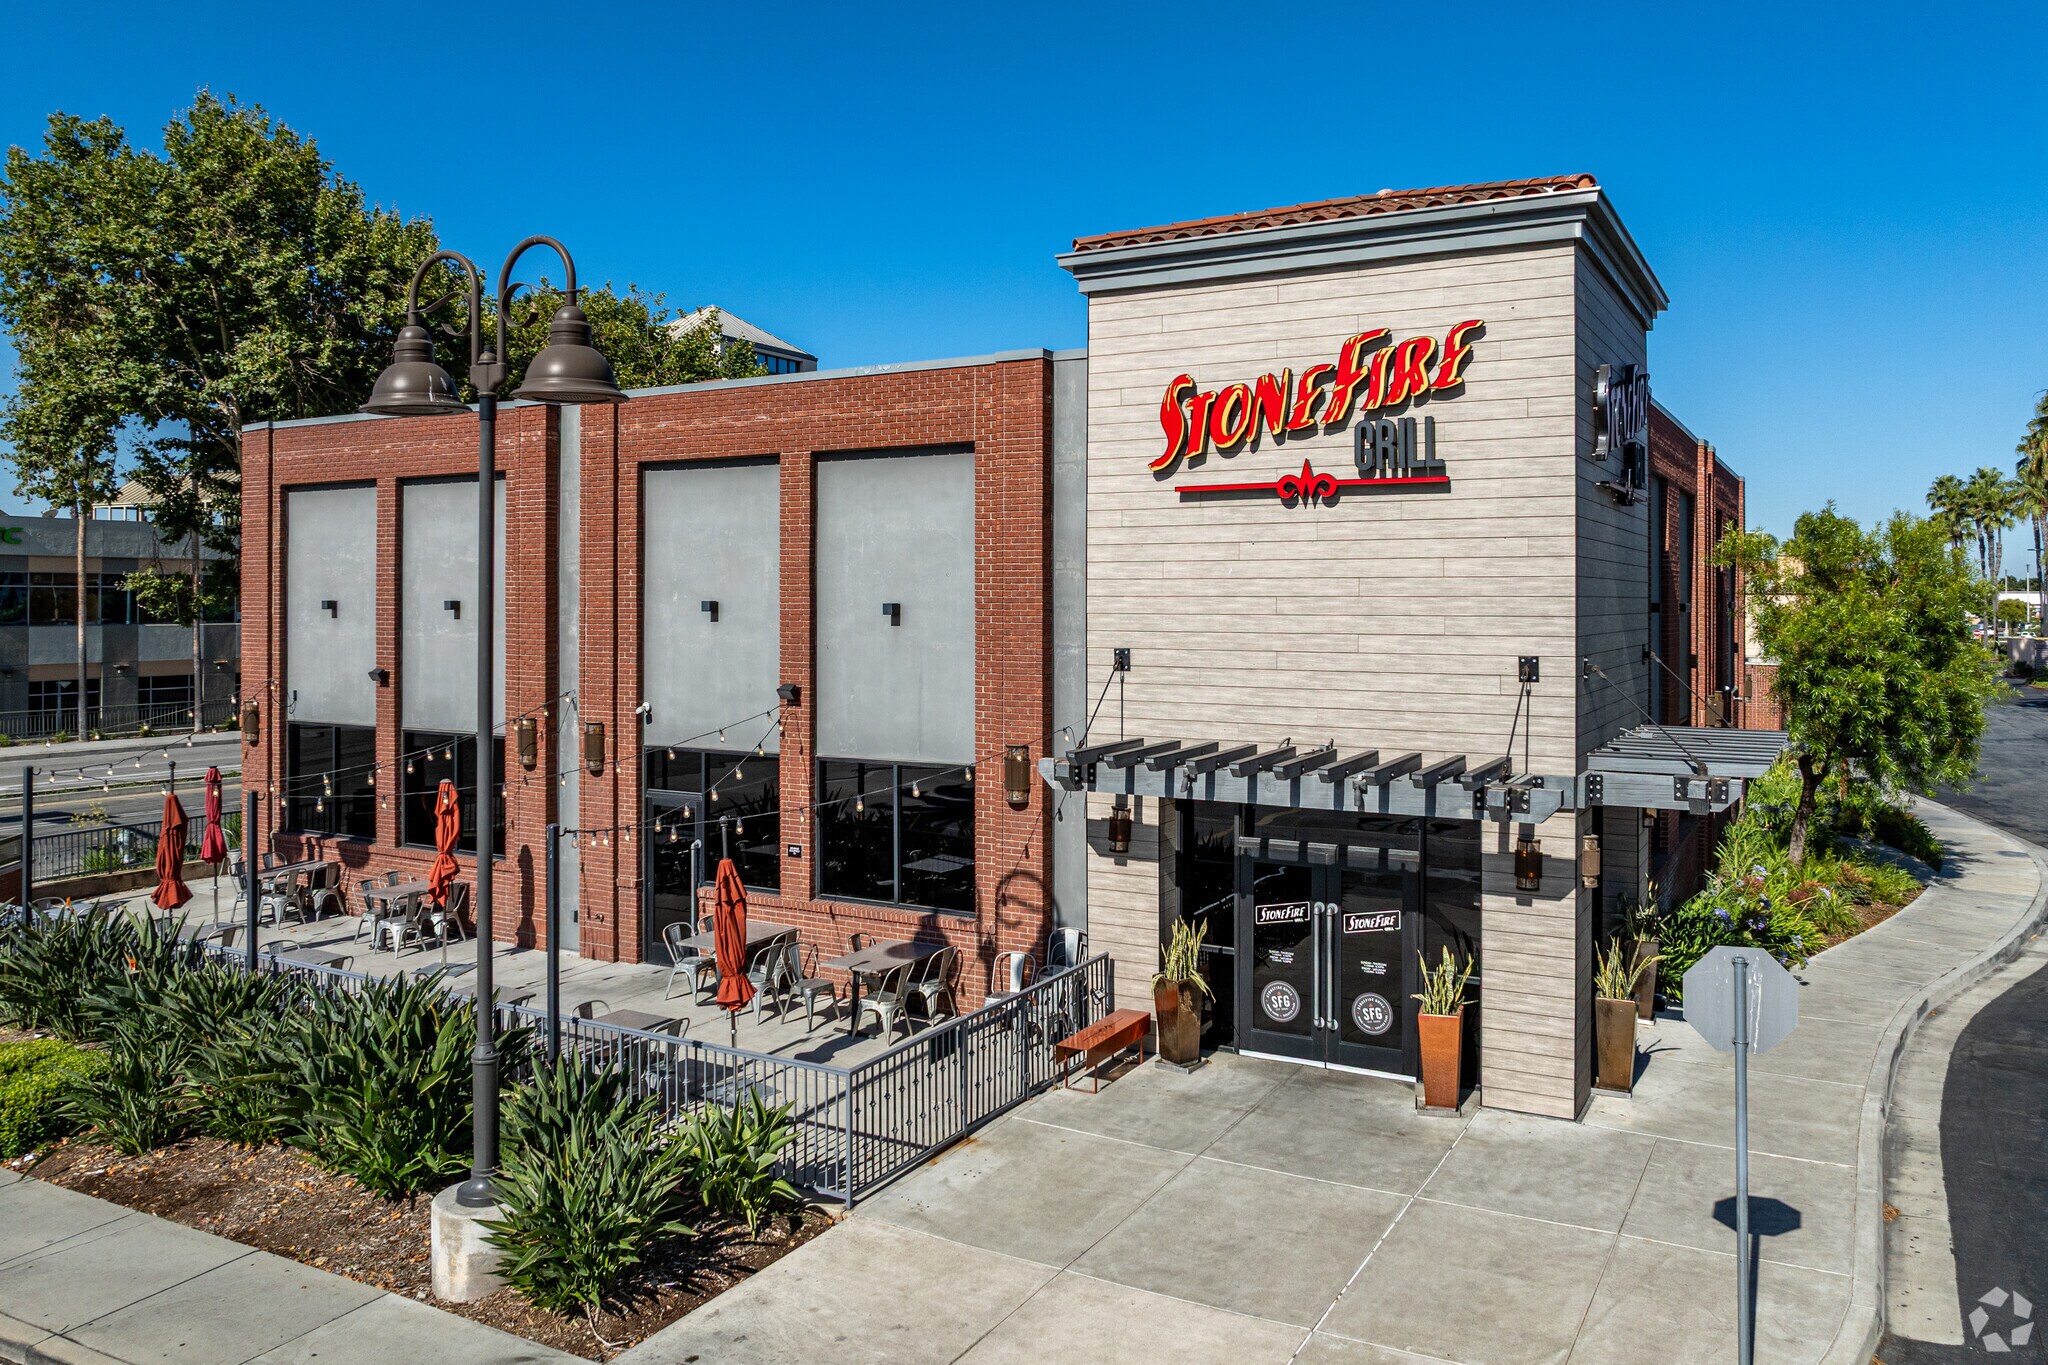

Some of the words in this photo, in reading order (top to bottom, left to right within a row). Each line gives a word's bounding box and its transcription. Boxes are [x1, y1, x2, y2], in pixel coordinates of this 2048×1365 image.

[1148, 319, 1485, 472] STONEFIRE
[1354, 415, 1444, 472] GRILL
[1260, 905, 1306, 922] STONEFIRE
[1348, 914, 1397, 931] STONEFIRE
[1271, 995, 1291, 1009] SFG
[1362, 1007, 1383, 1021] SFG
